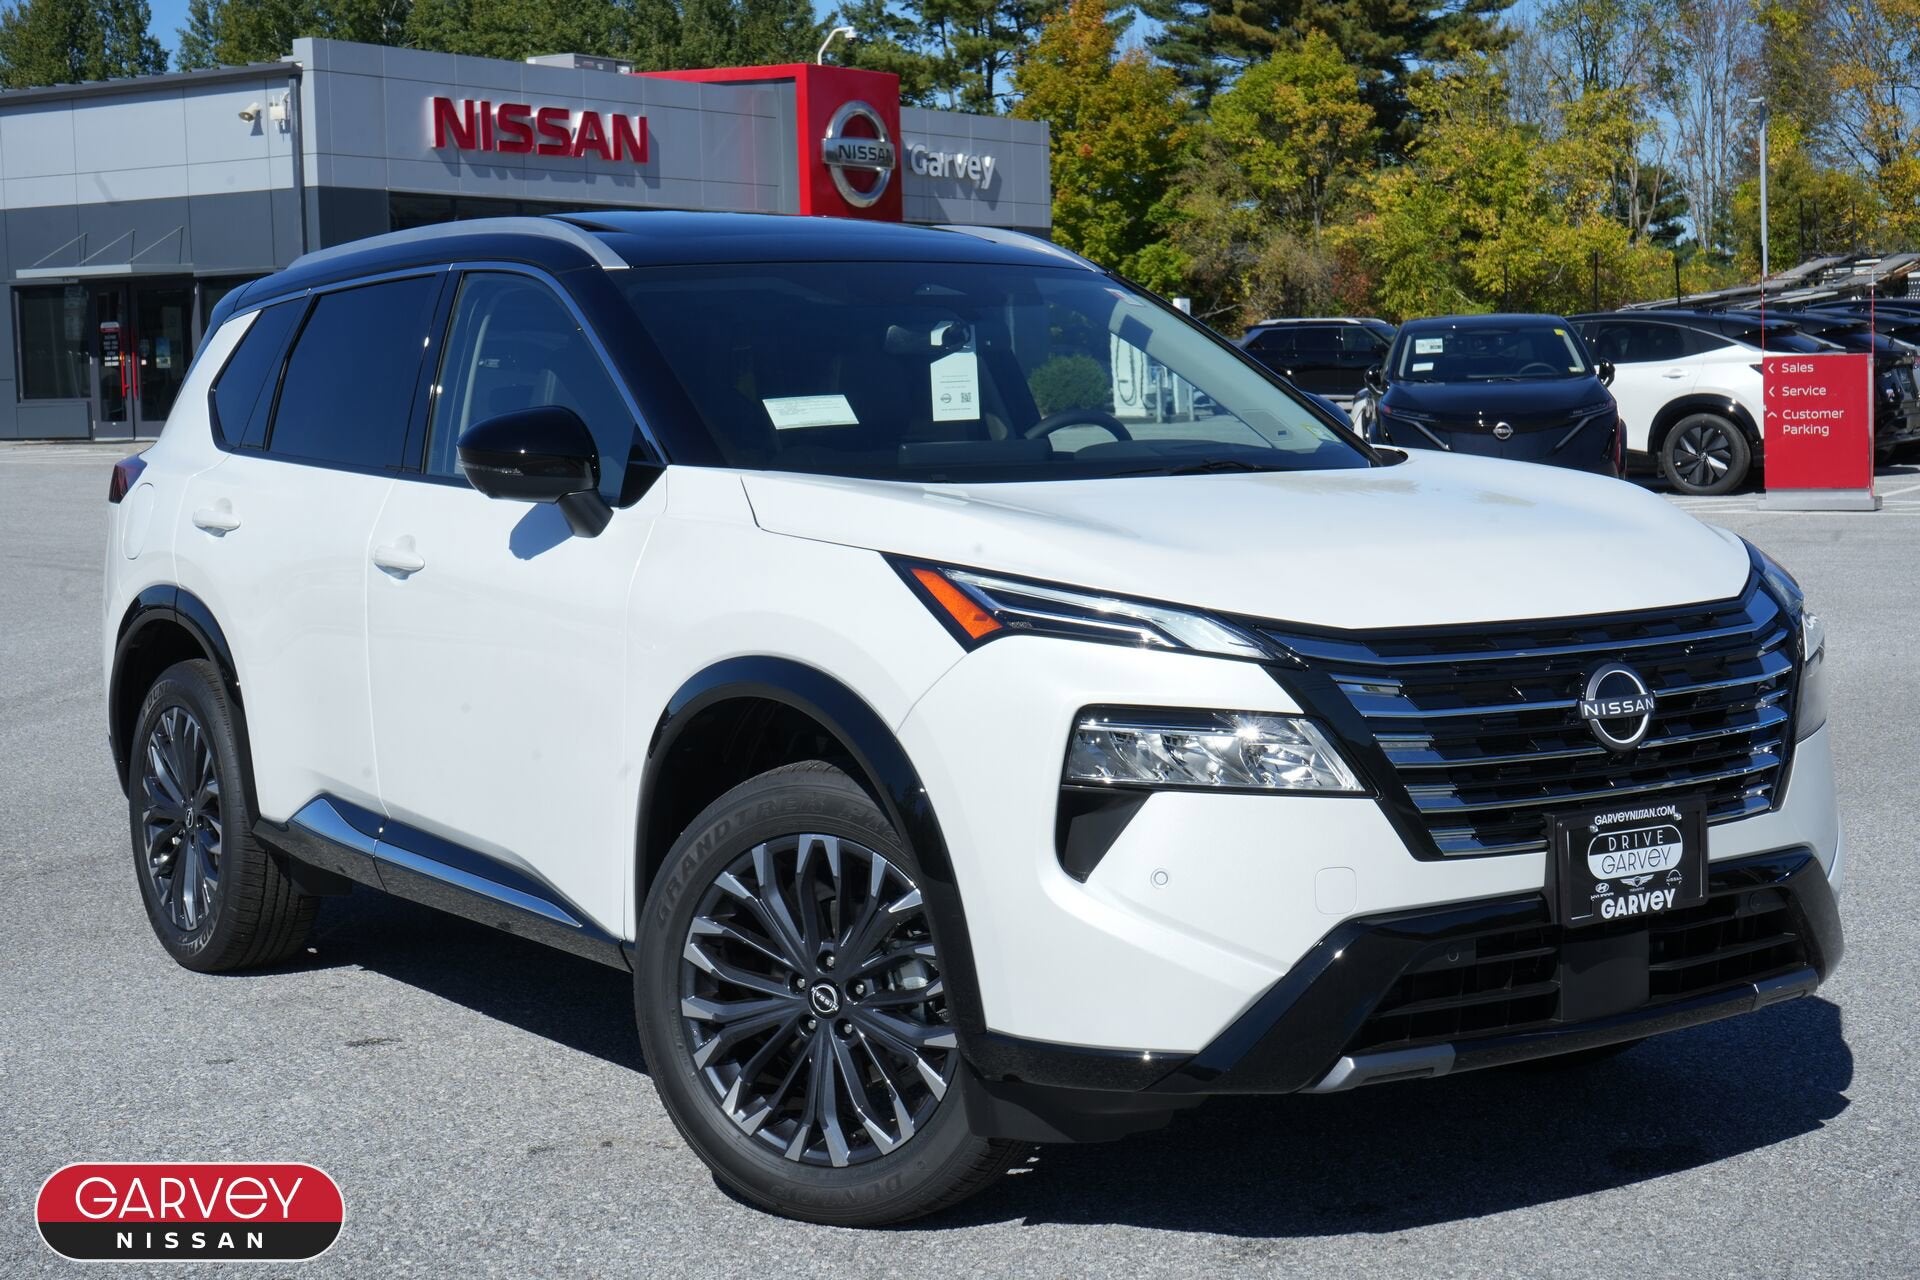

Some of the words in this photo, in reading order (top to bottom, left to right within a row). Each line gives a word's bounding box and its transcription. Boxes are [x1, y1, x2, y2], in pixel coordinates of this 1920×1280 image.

[432, 97, 648, 163] NISSAN
[838, 144, 893, 162] NISSAN
[910, 144, 996, 190] Garvey
[1781, 362, 1814, 373] Sales
[1782, 386, 1827, 397] Service
[1782, 409, 1845, 420] Customer
[1783, 424, 1830, 437] Parking
[1584, 698, 1654, 716] NISSAN
[1608, 829, 1665, 851] DRIVE
